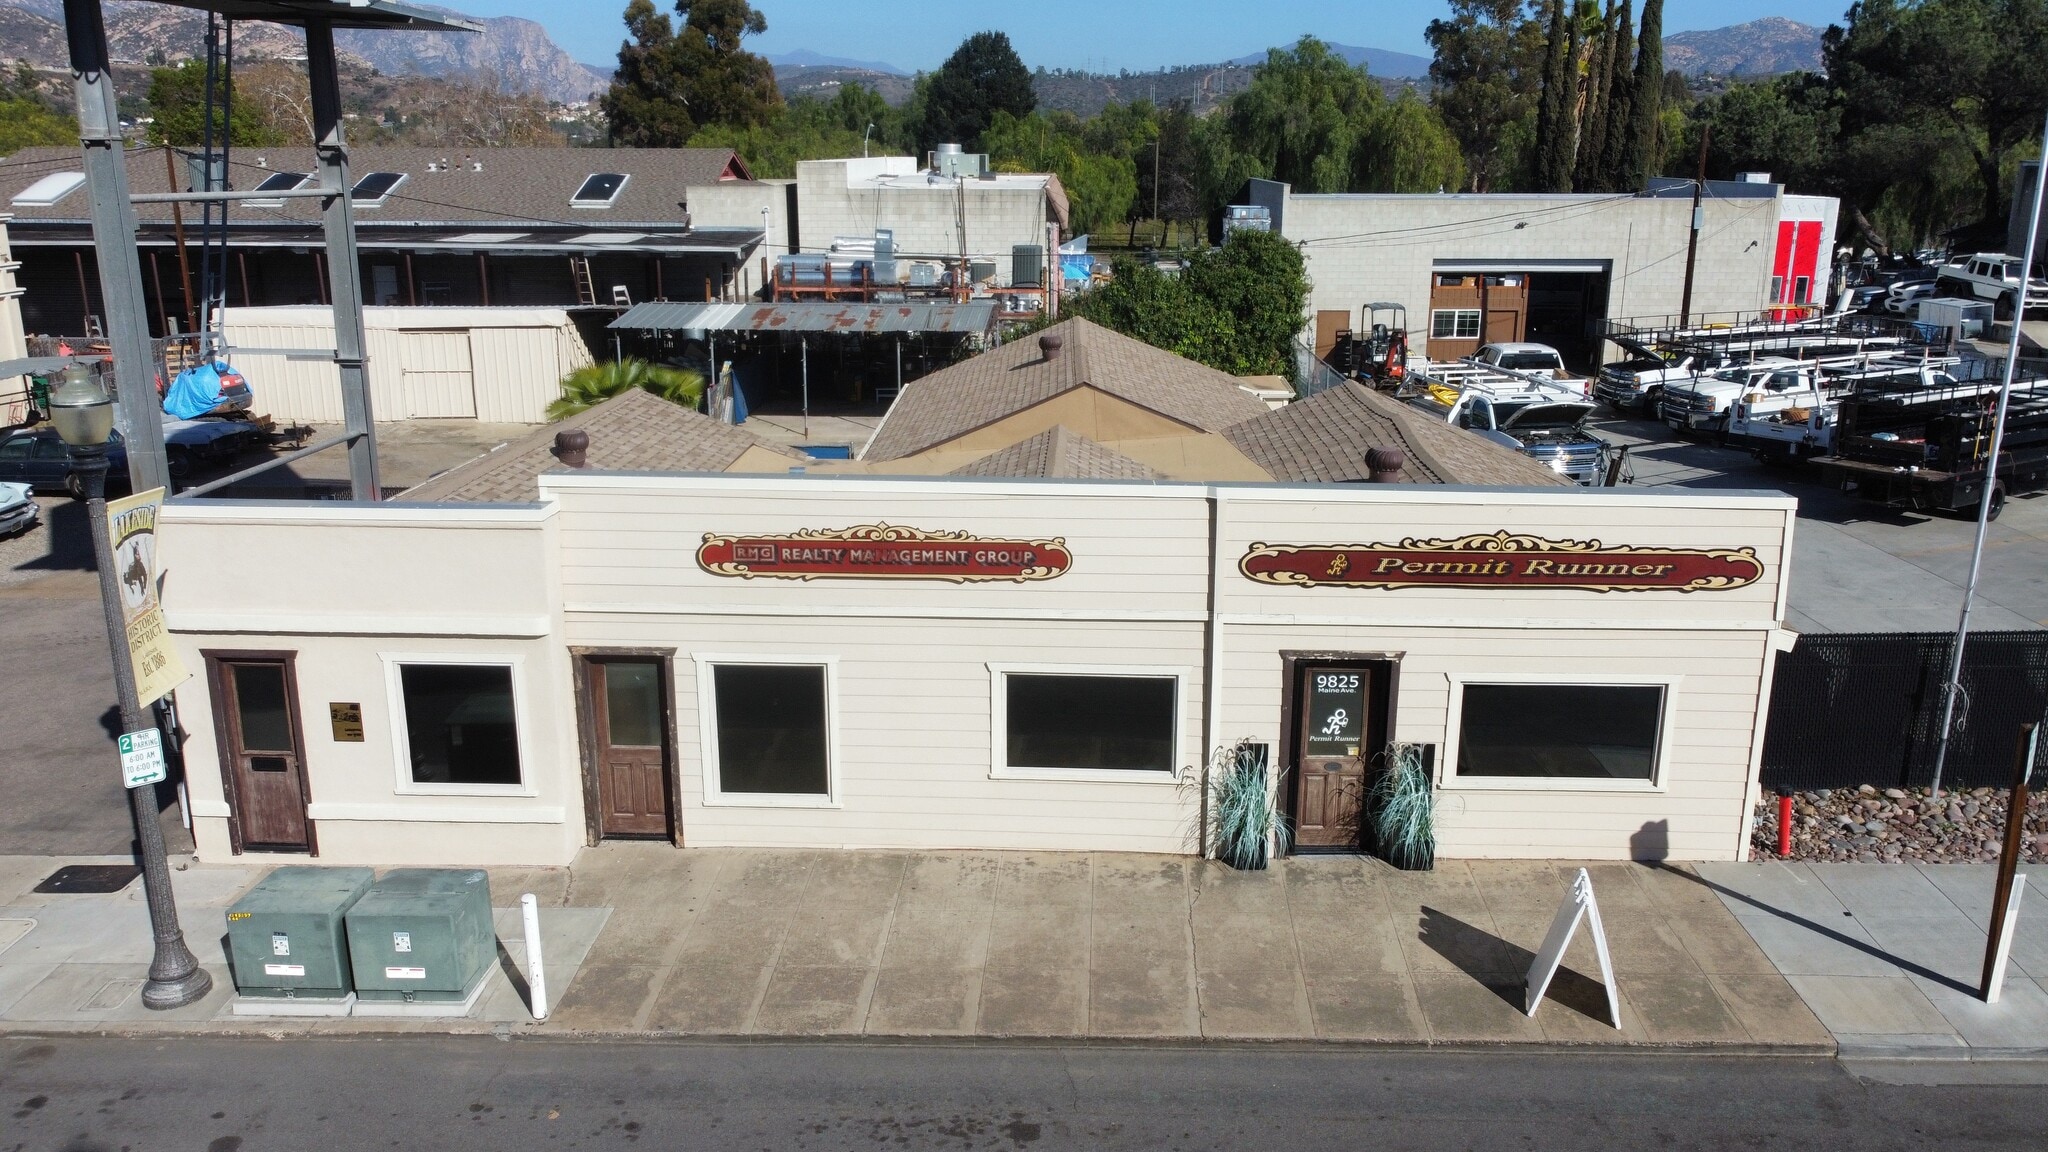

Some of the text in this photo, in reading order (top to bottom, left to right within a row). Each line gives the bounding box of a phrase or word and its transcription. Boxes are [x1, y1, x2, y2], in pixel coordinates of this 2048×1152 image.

[113, 505, 155, 550] LAKESIDE
[736, 547, 1034, 565] RMG REALTY MANAGEMENT GROUP
[1372, 557, 1673, 577] Permit Runner
[127, 609, 159, 640] HISTORIC
[130, 622, 163, 654] DISTRICT
[1317, 675, 1359, 688] 9825
[121, 738, 131, 750] 2
[133, 738, 159, 749] PARKING
[146, 751, 155, 759] AM
[152, 760, 161, 768] PM
